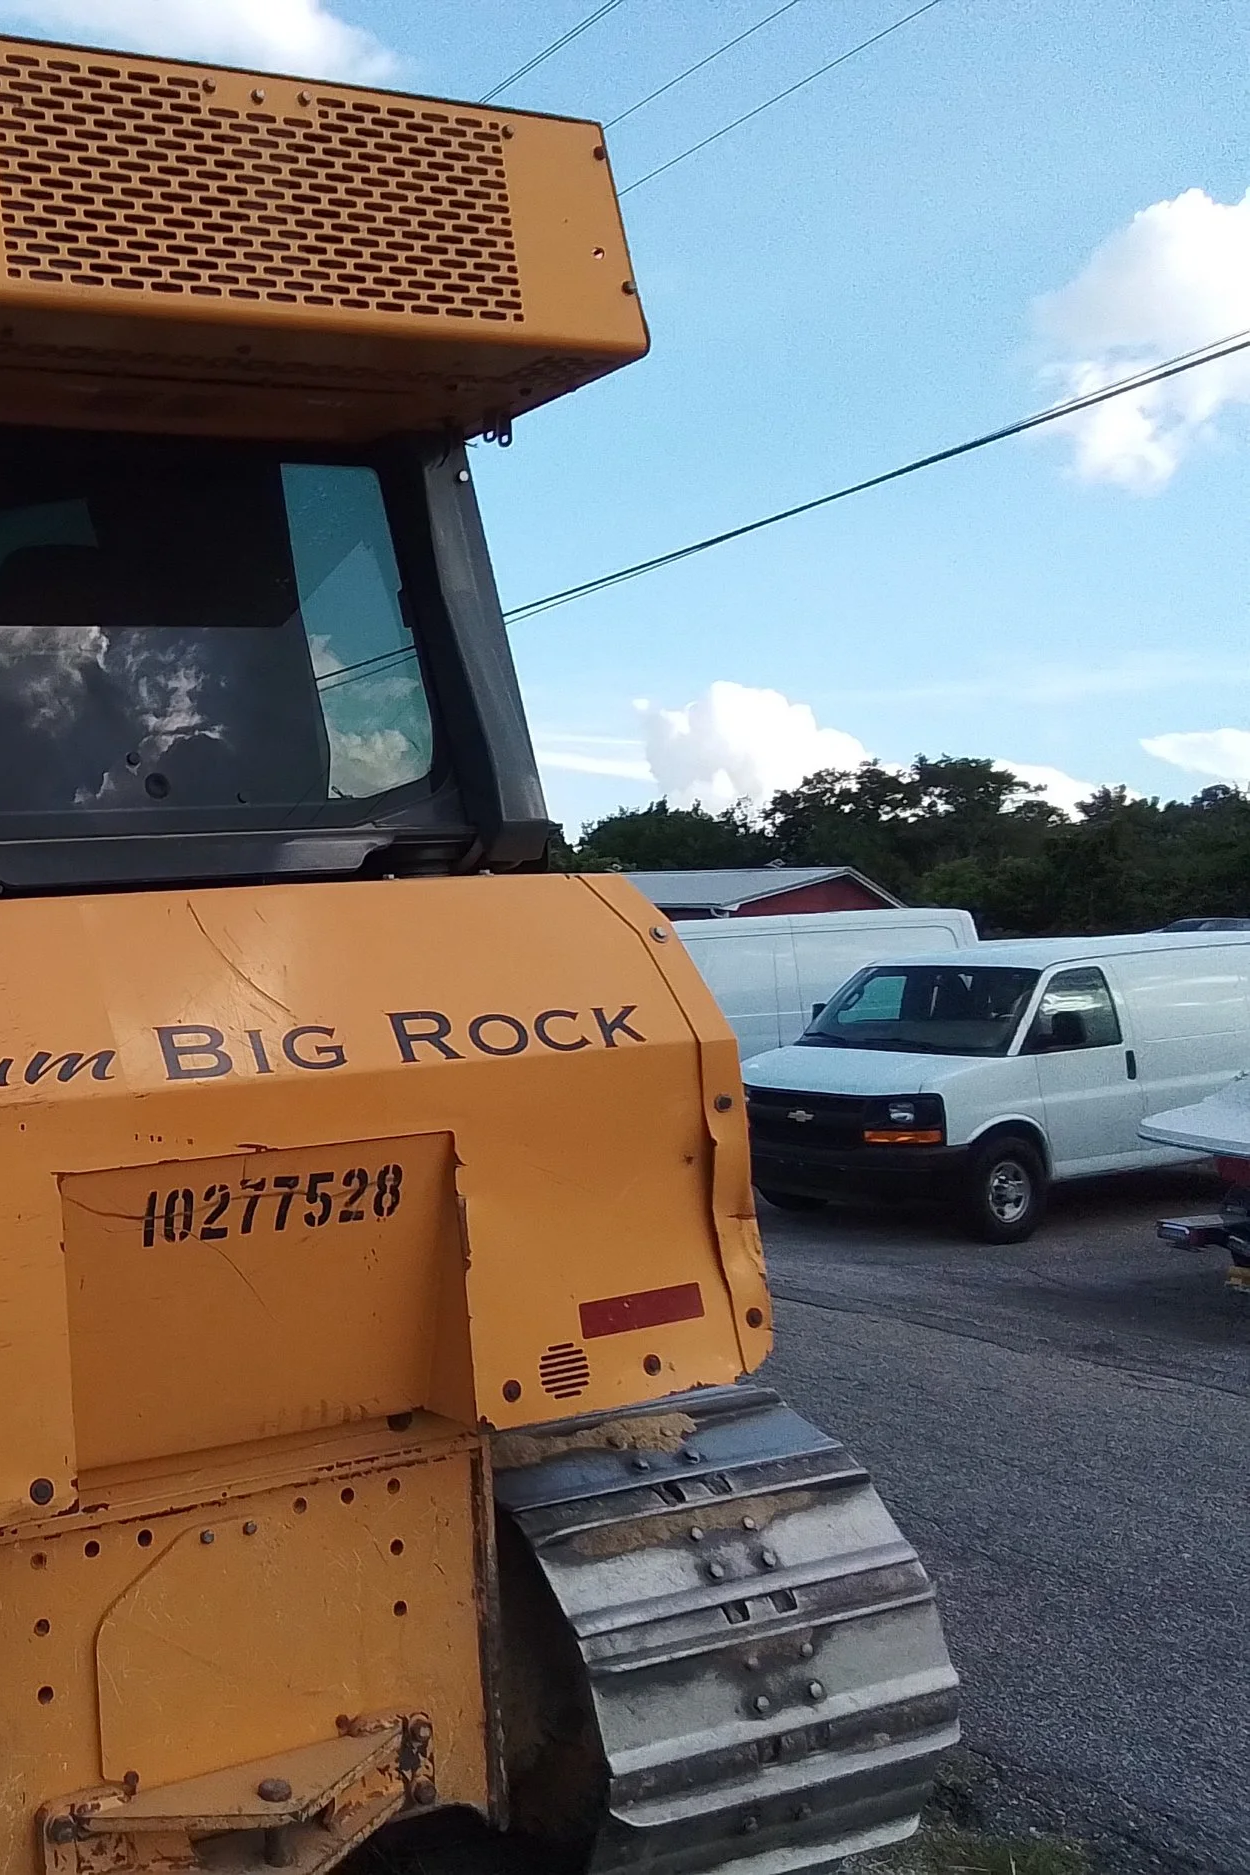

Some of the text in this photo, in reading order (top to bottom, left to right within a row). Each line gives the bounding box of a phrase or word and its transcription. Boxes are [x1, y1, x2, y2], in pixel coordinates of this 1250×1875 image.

[151, 1023, 350, 1082] BIG
[384, 1004, 648, 1065] ROCK
[142, 1163, 404, 1249] 10277528
